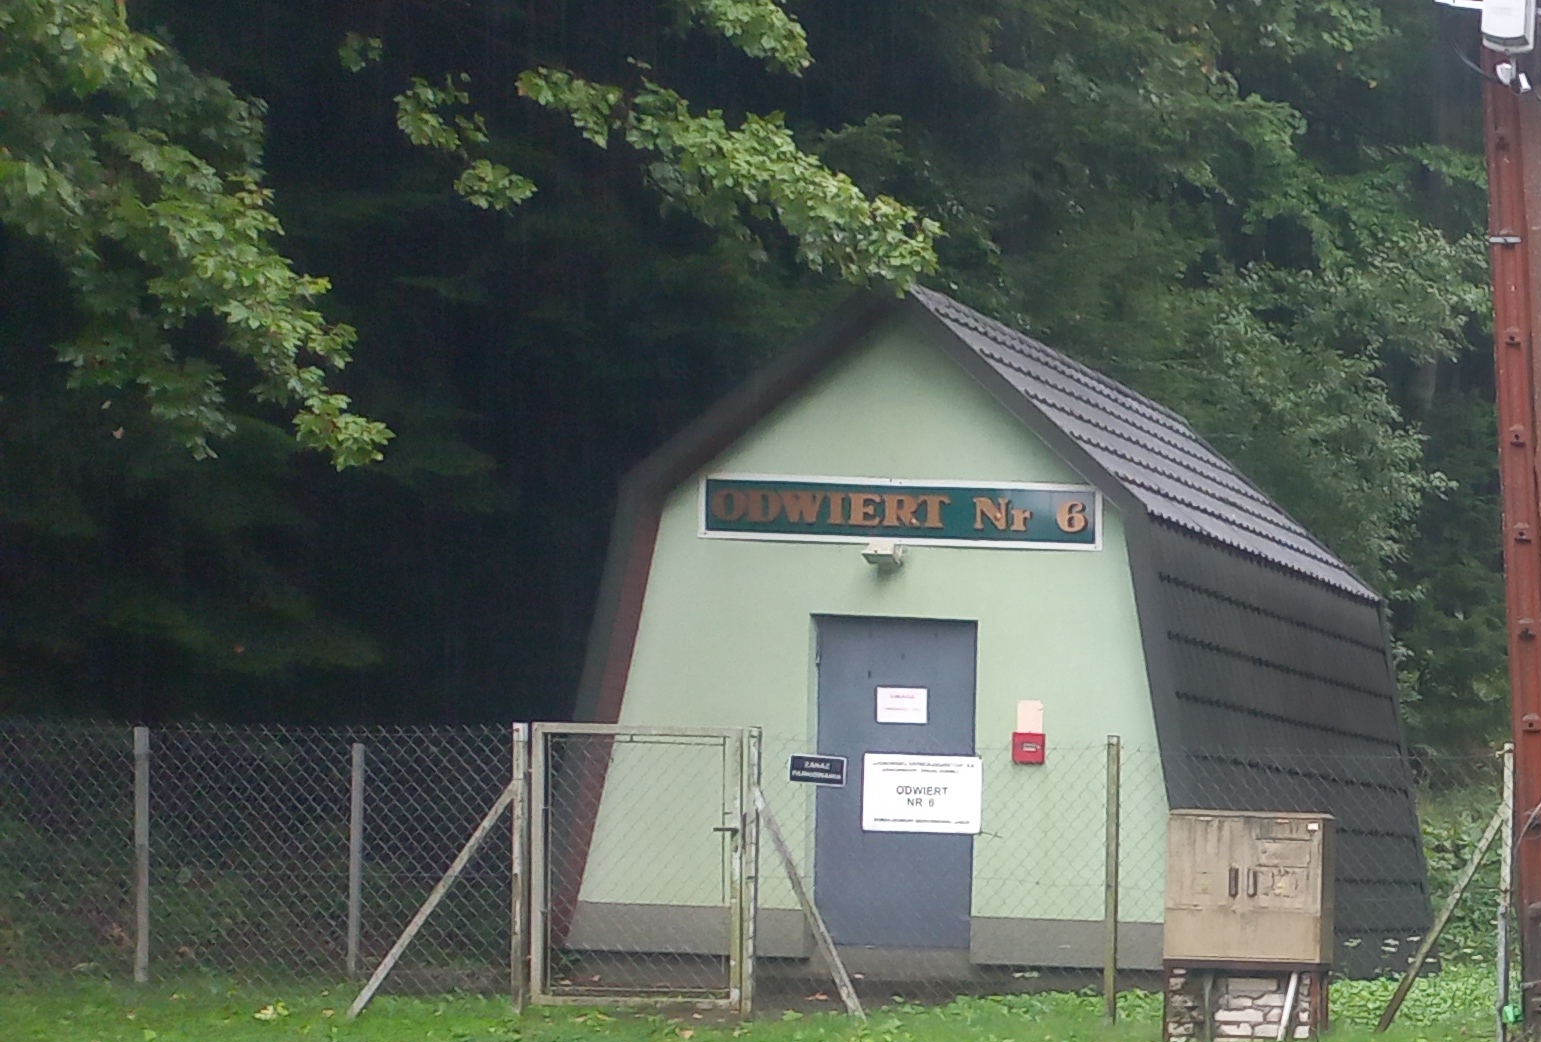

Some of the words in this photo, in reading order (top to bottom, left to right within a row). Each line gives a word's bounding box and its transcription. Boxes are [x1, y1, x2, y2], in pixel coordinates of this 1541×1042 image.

[711, 487, 951, 529] ODWIERT
[972, 496, 1033, 532] Nr
[1055, 499, 1089, 534] 6
[896, 785, 949, 796] ODWIERT
[906, 797, 923, 807] NR
